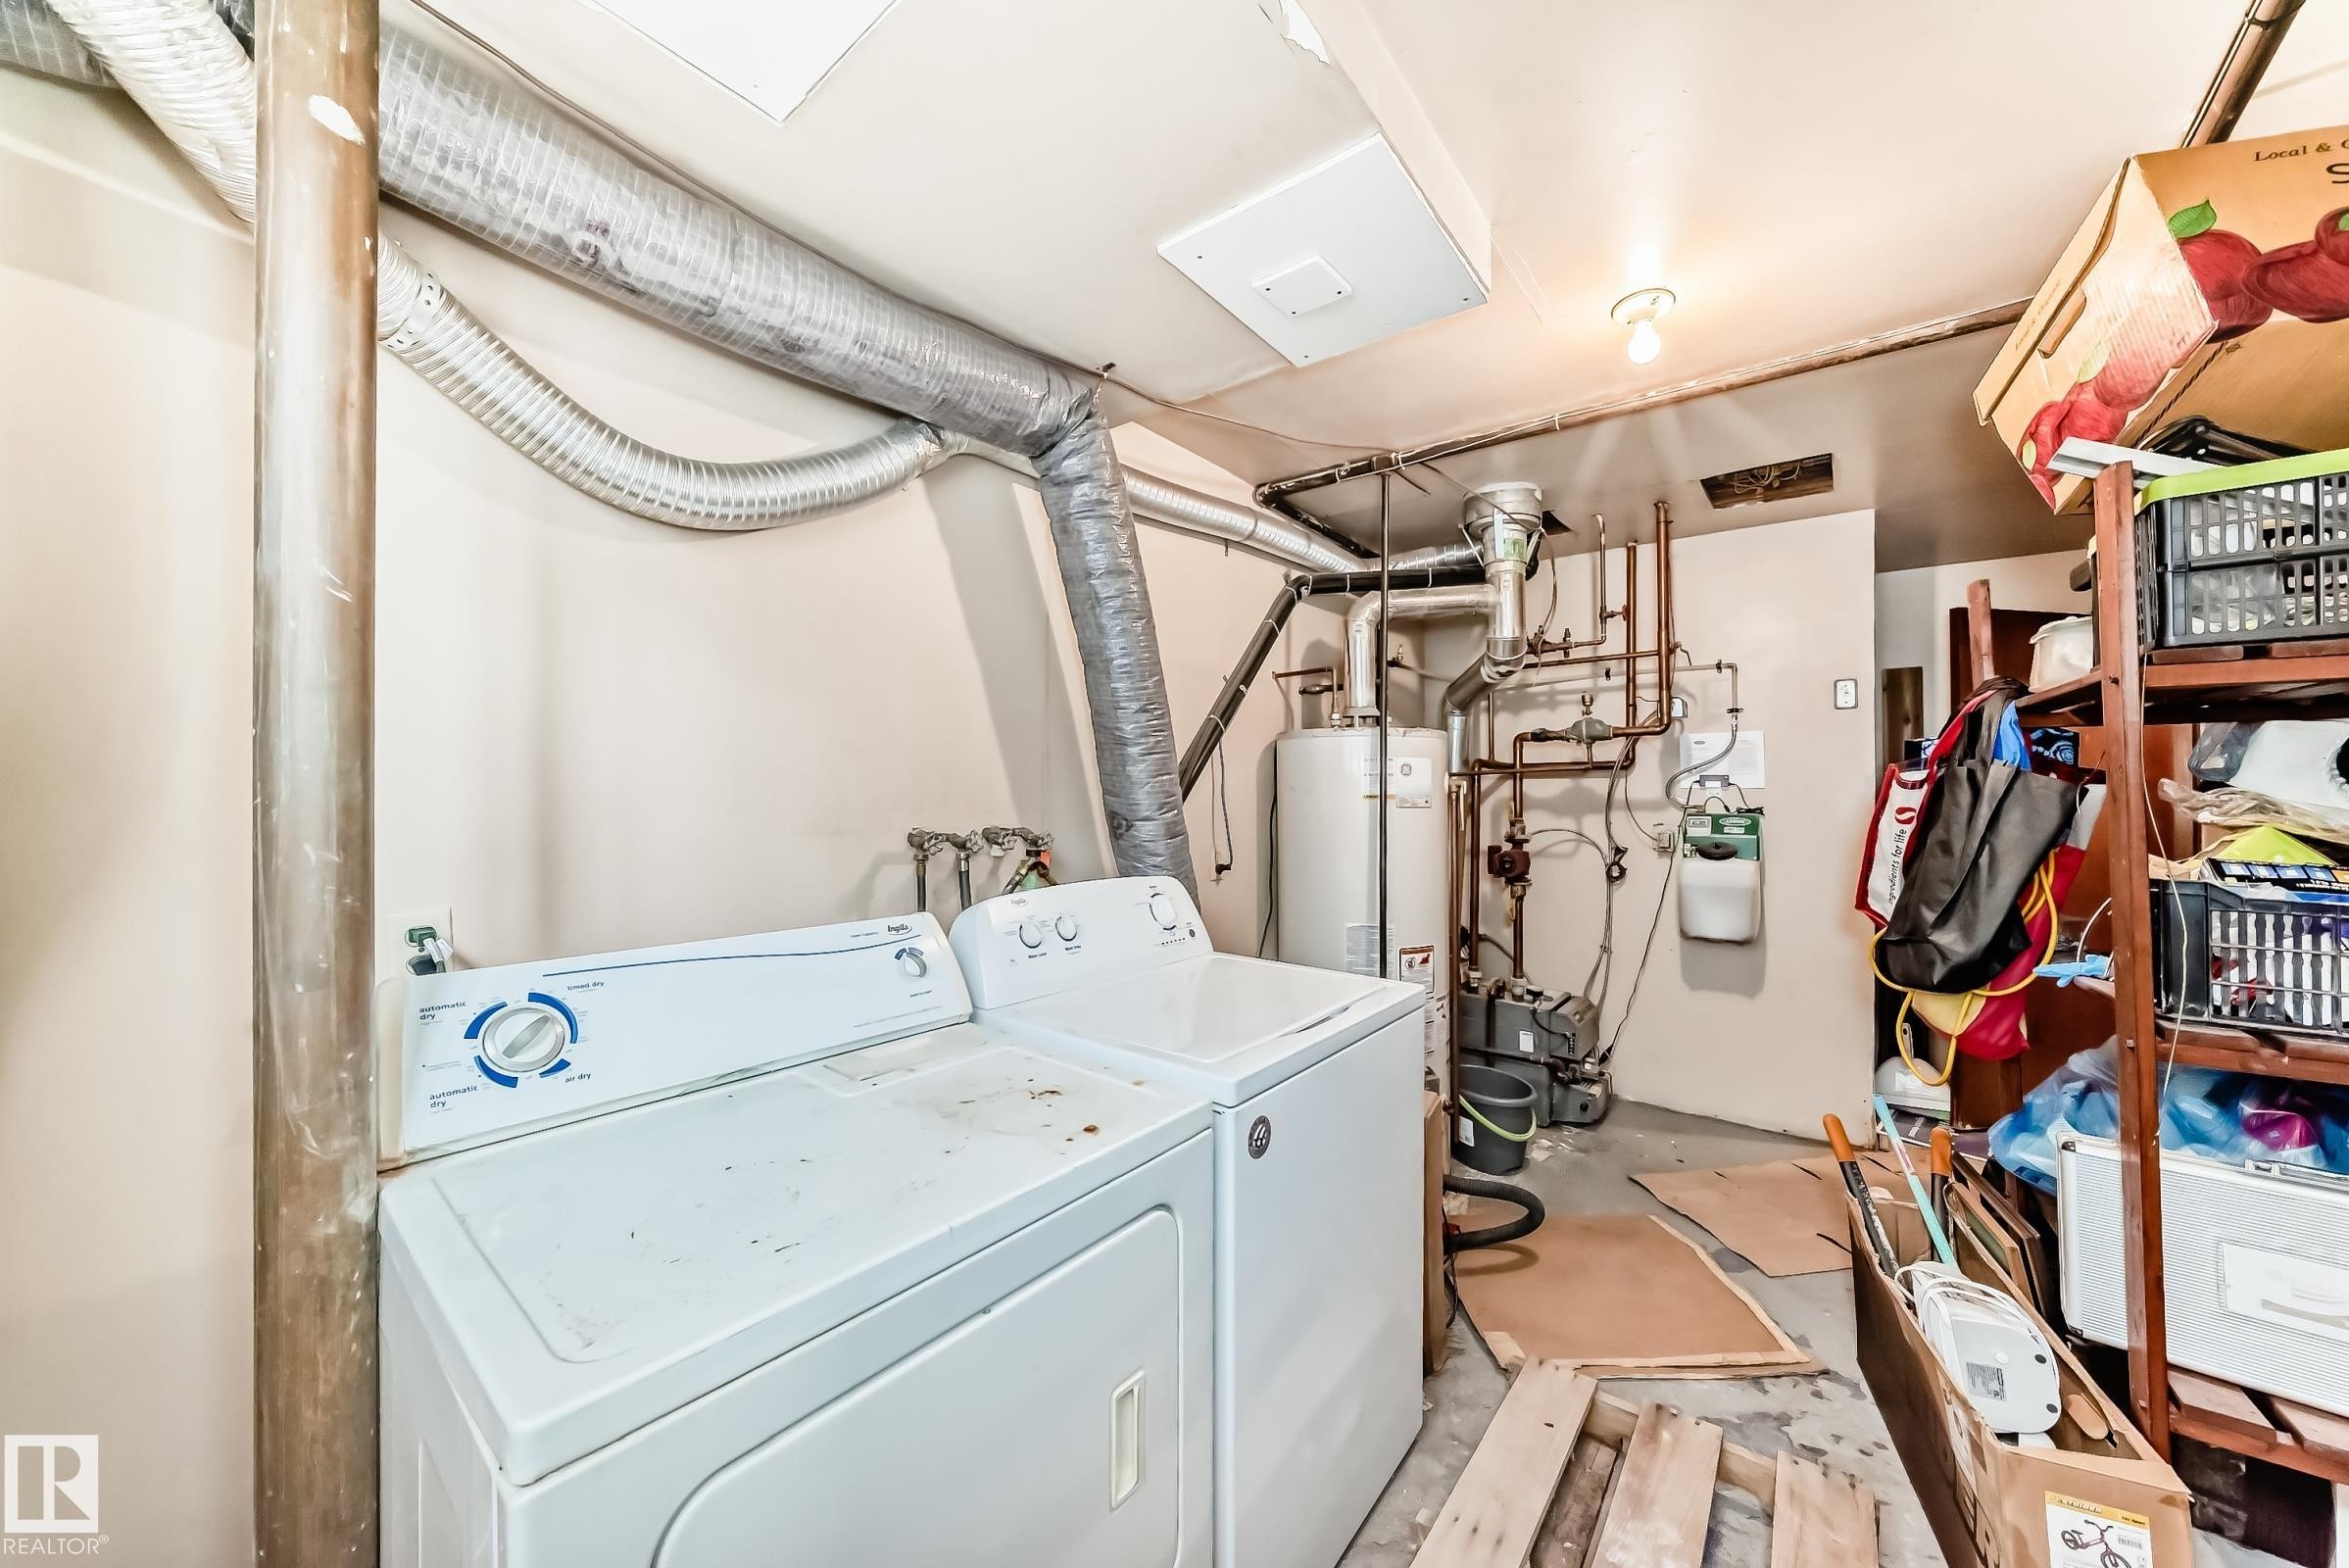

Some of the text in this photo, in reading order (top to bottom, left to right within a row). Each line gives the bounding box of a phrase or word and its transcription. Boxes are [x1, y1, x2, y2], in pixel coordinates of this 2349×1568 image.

[2254, 145, 2308, 162] Local
[2315, 142, 2333, 153] &
[1887, 828, 1907, 905] ingredients for life
[592, 980, 605, 989] dry
[418, 1001, 466, 1013] automatic
[419, 1012, 436, 1021] dry
[577, 1072, 592, 1081] dry
[429, 1085, 479, 1101] automatic
[429, 1100, 447, 1108] dry
